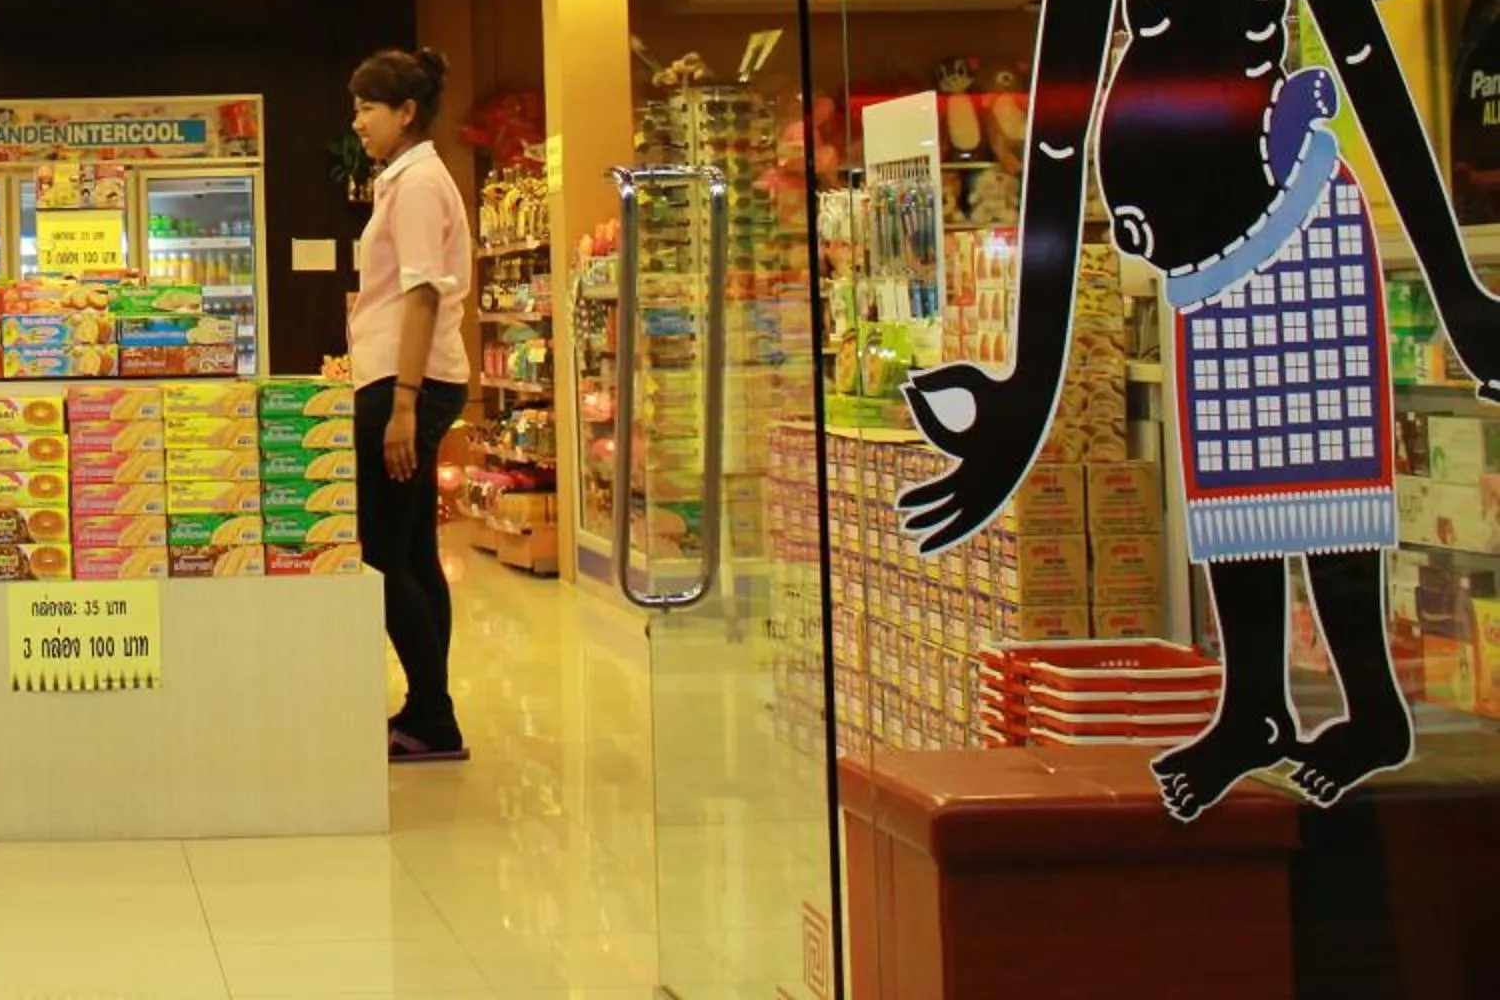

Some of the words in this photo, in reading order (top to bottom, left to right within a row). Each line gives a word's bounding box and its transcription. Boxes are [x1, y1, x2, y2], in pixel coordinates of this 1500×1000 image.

[83, 599, 100, 616] 35
[106, 599, 127, 616] บาท
[23, 636, 32, 659] 3
[41, 626, 81, 659] กล่อง
[89, 635, 115, 658] 100
[123, 635, 149, 658] บาท
